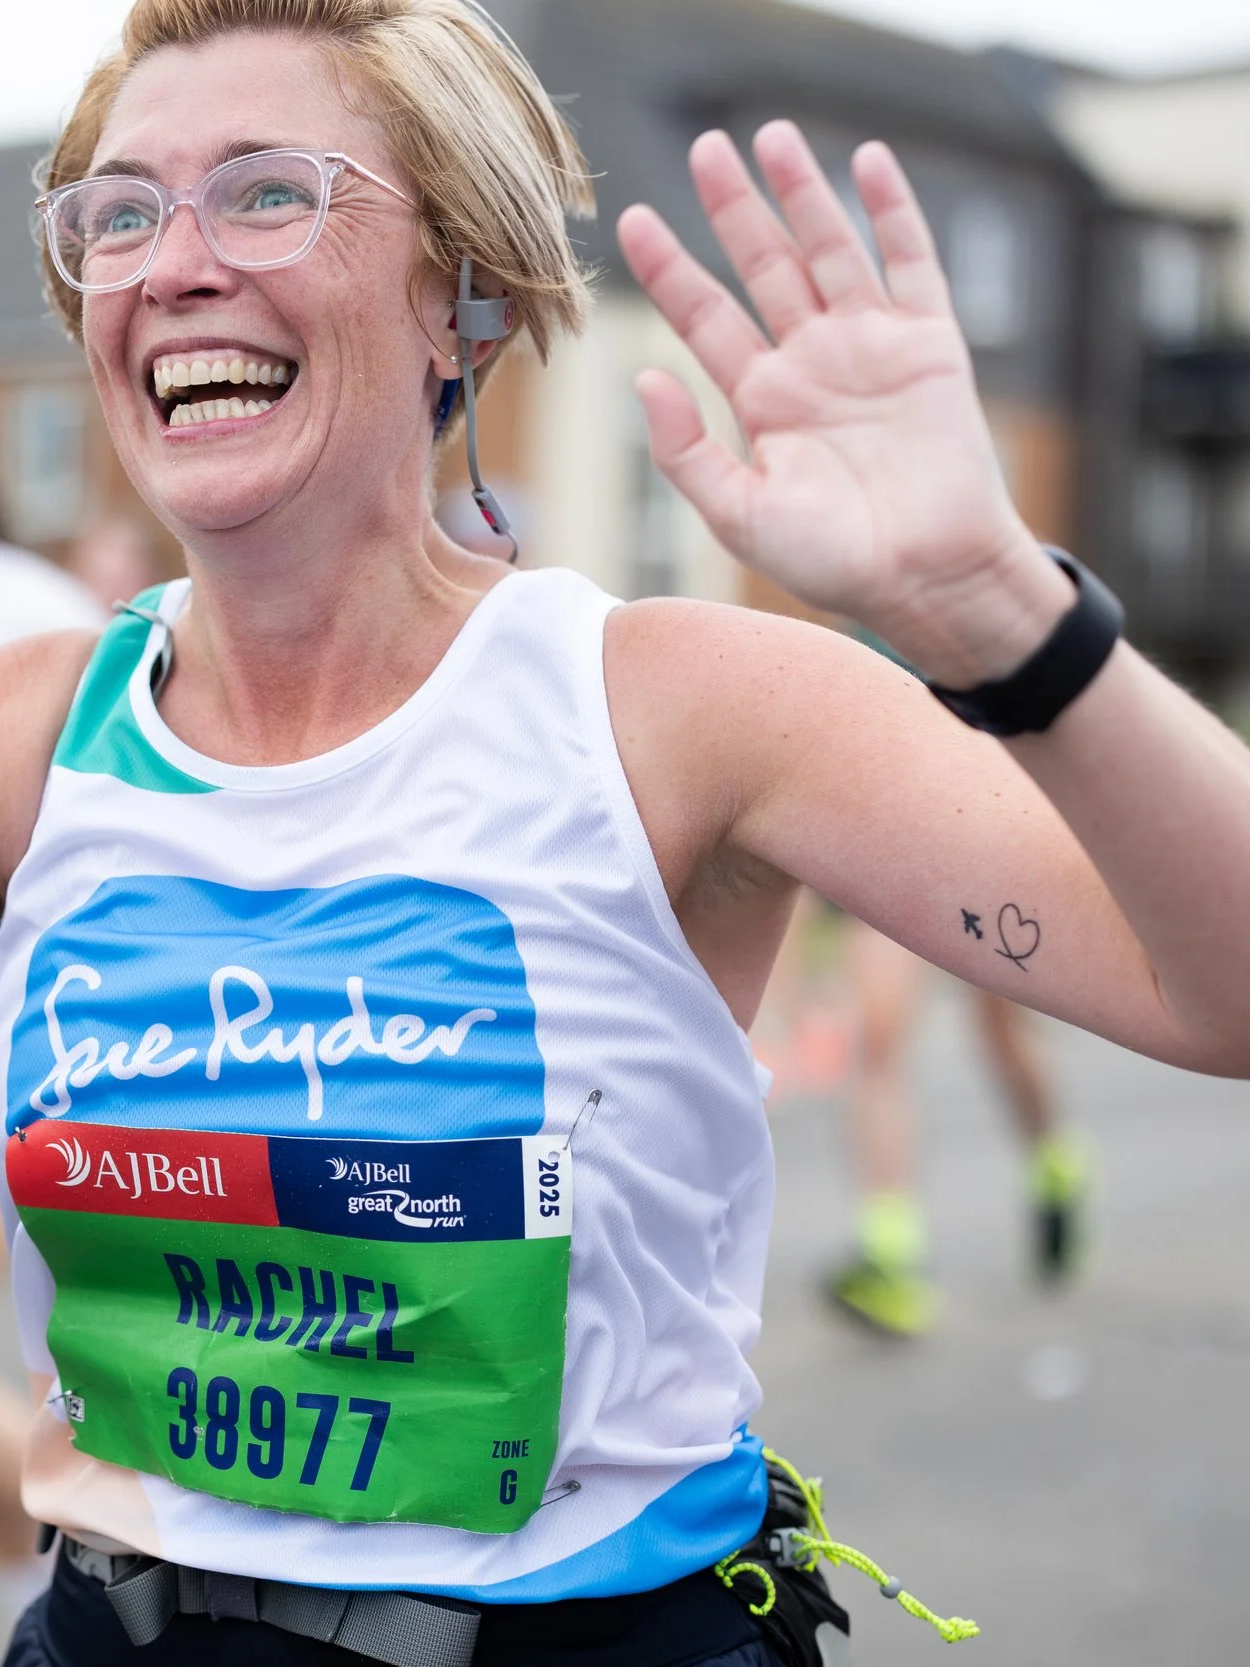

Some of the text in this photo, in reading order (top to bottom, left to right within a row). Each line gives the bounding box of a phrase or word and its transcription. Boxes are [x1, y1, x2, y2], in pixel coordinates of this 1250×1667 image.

[30, 964, 497, 1121] Sue Ryder
[348, 1194, 461, 1214] great north
[538, 1157, 560, 1218] 2025
[433, 1215, 465, 1228] run
[162, 1252, 415, 1364] RACHEL
[166, 1366, 392, 1492] 38977
[491, 1439, 530, 1459] ZONE
[499, 1469, 518, 1505] G
